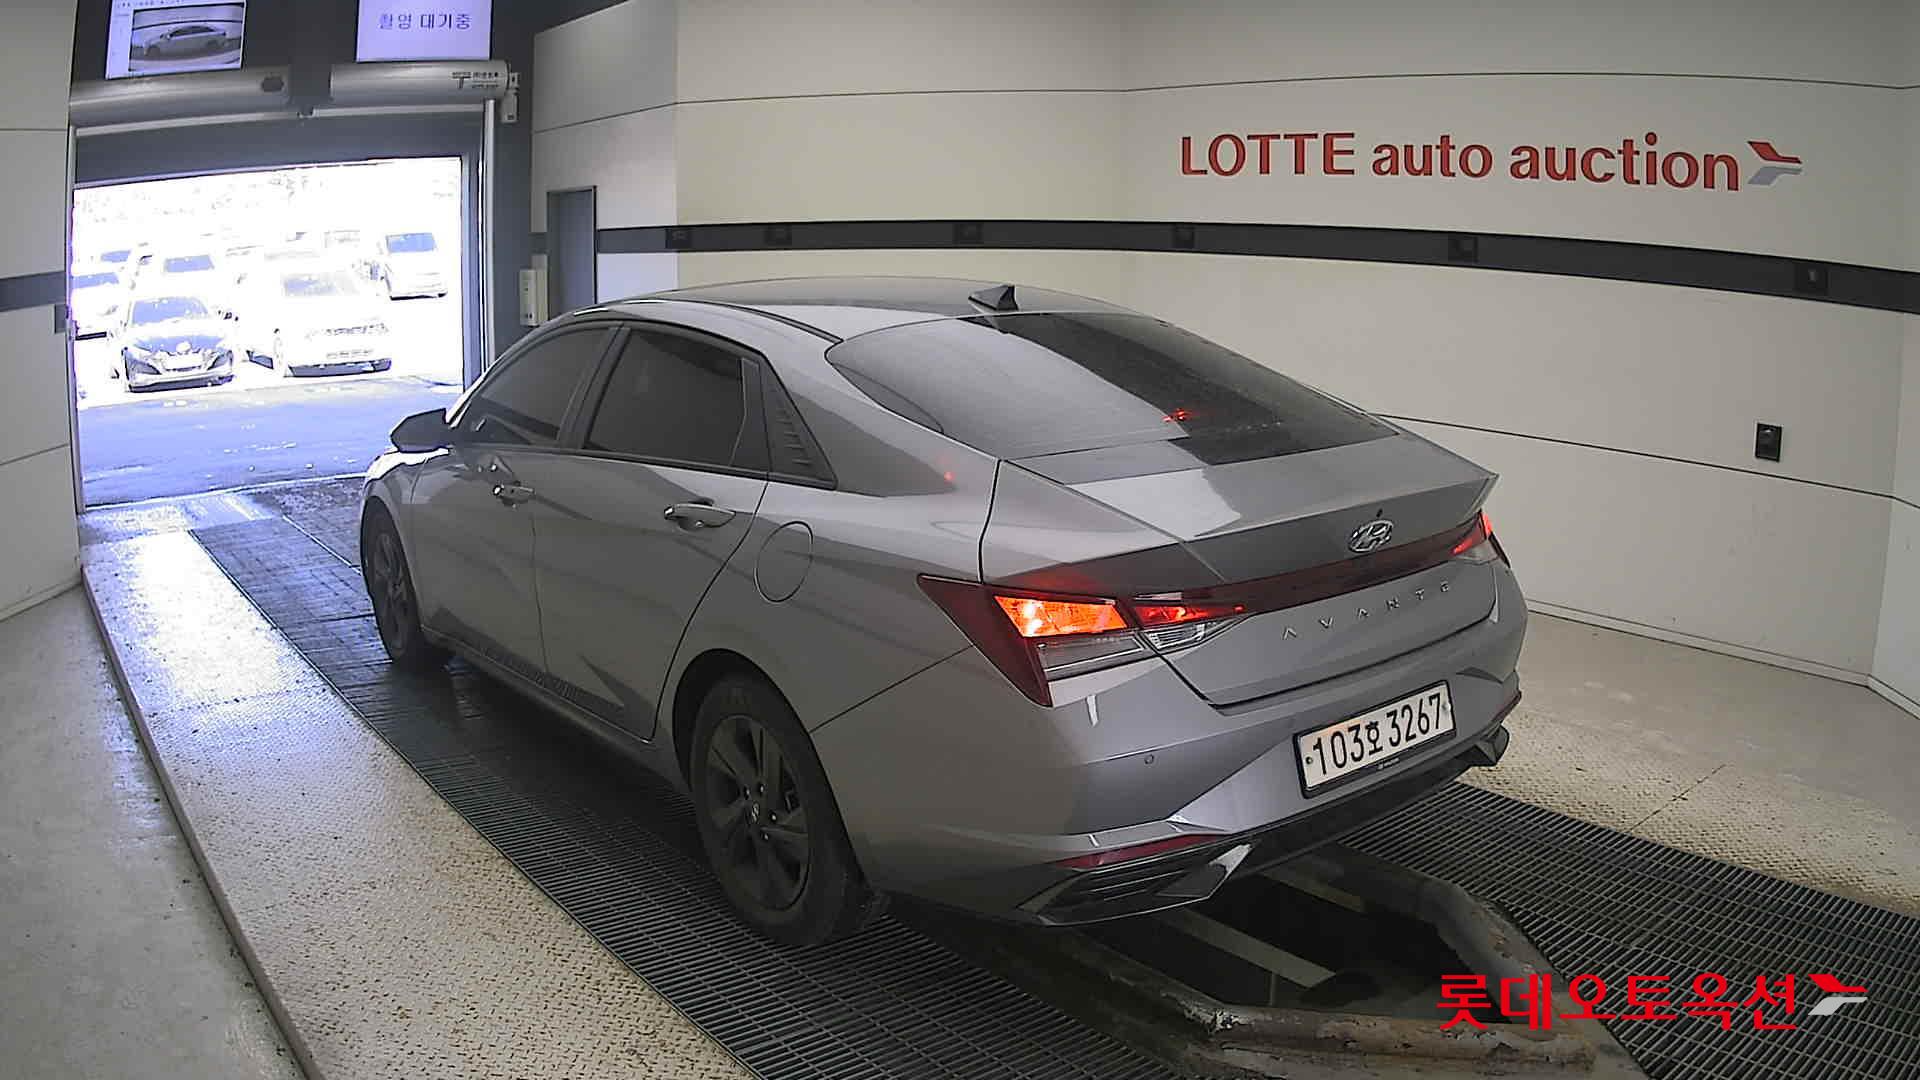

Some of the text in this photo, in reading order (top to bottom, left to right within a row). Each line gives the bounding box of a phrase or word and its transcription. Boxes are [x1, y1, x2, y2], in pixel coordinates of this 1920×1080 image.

[420, 13, 472, 30] 대기중
[1181, 132, 1740, 191] LOTTE auto auction
[1282, 581, 1450, 640] AVANTE
[1313, 693, 1441, 775] 103호 3267
